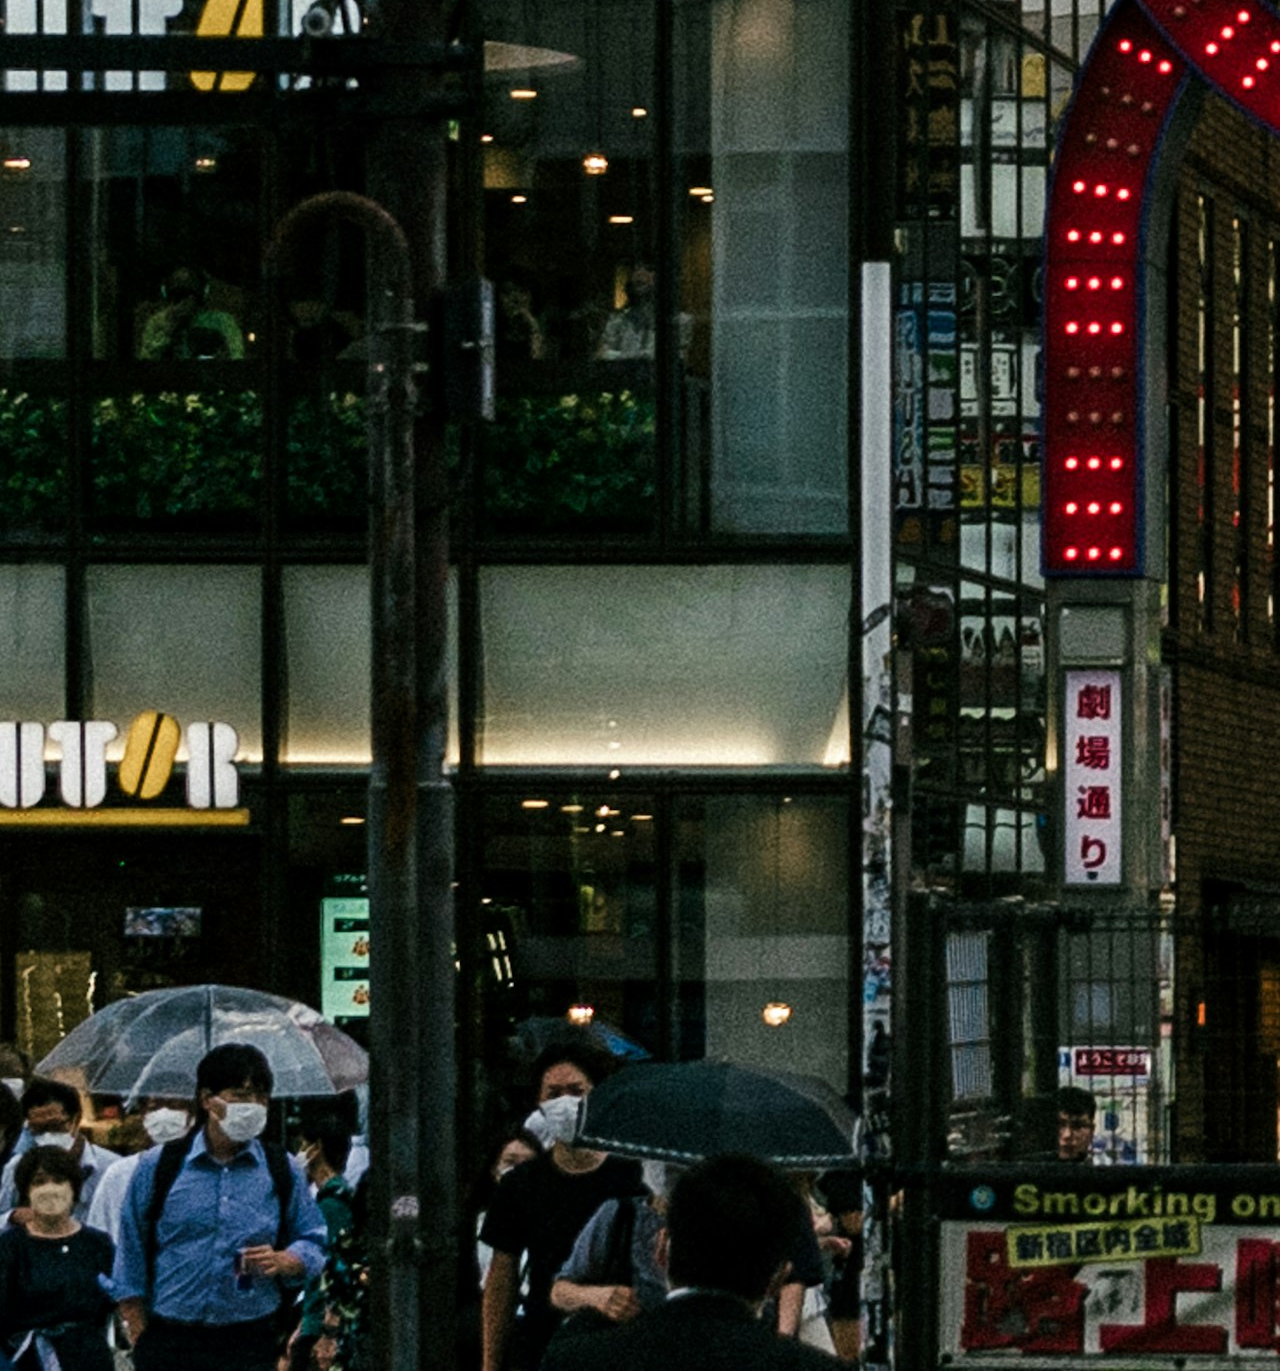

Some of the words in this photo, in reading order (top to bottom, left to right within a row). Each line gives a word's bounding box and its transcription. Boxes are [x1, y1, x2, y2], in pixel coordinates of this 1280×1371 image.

[1077, 684, 1112, 874] 劇場通り
[1013, 1183, 1217, 1221] Smorking
[1015, 1223, 1192, 1262] 新宿区内全域
